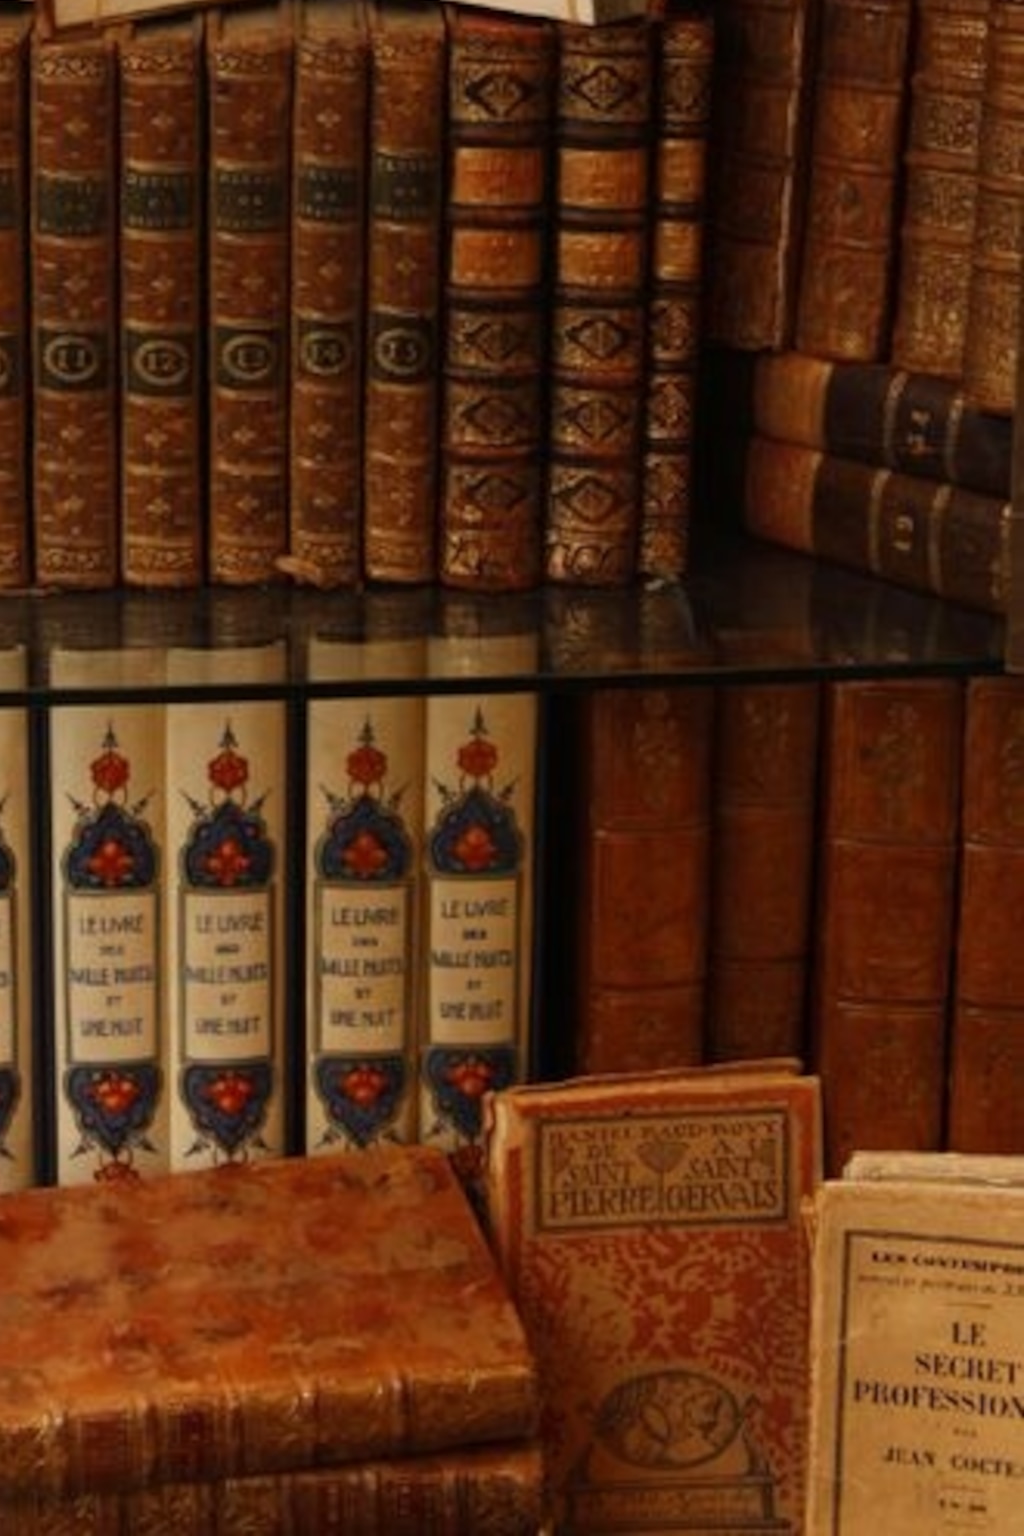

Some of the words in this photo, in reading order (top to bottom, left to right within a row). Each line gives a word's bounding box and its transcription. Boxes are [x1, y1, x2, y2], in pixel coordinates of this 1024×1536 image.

[332, 908, 352, 925] LE
[354, 908, 399, 926] LIVRE
[441, 901, 459, 918] LE
[465, 898, 509, 916] LIVRE
[79, 918, 96, 935] LE
[102, 916, 143, 935] LIVRE
[195, 916, 213, 933] LE
[217, 914, 264, 932] LIVRE
[564, 1161, 632, 1188] SAINT
[685, 1157, 751, 1180] SAINT
[550, 1186, 653, 1219] PIERRE
[666, 1180, 778, 1212] GERVAIS
[951, 1321, 986, 1346] LE
[914, 1352, 1022, 1385] SECRET
[883, 1445, 934, 1467] JEAN
